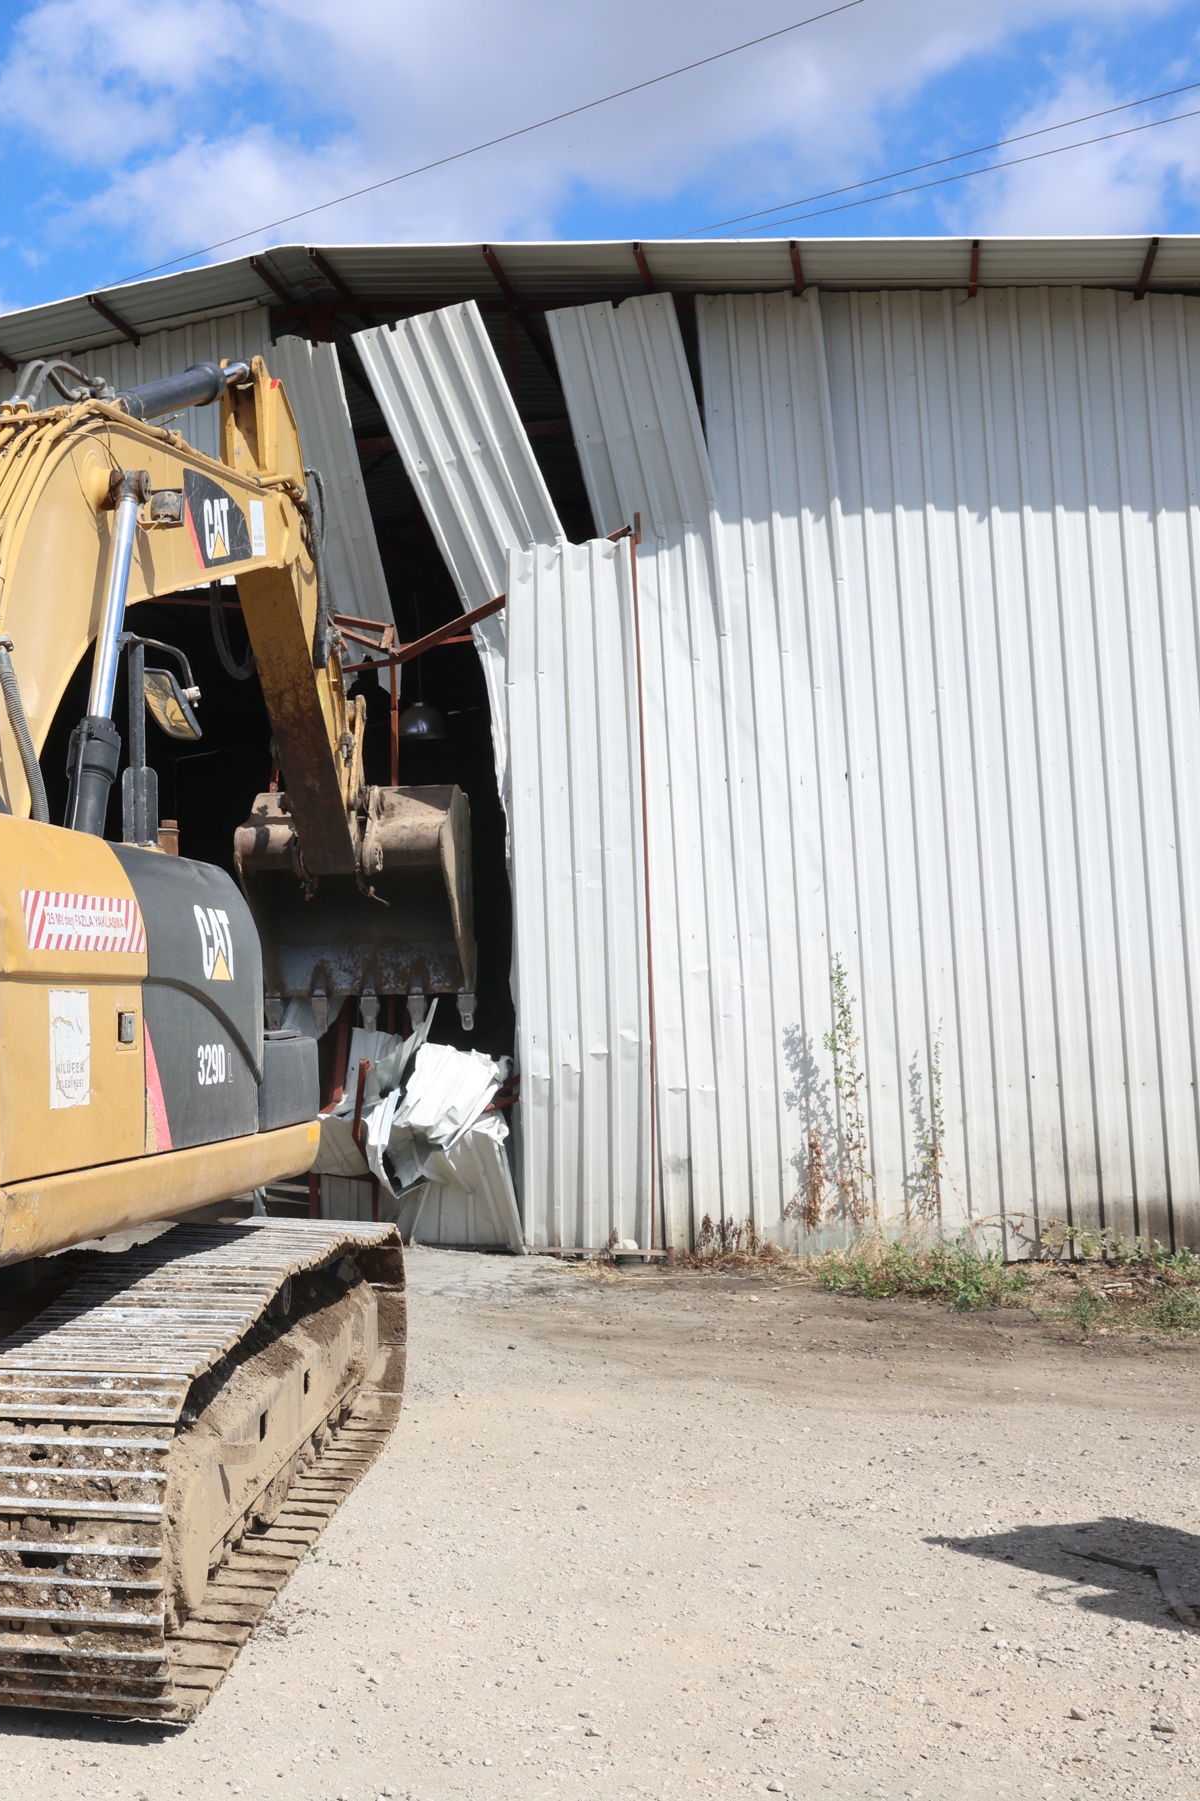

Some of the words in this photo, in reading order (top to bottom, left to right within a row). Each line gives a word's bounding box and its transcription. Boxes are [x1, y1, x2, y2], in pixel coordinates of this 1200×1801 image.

[203, 498, 230, 560] CAT
[47, 912, 56, 925] 25
[74, 914, 94, 927] FAZLA
[94, 915, 125, 931] YAKLAŞMA
[193, 904, 234, 981] CAT
[56, 1059, 85, 1075] NİLÜFER
[197, 1043, 226, 1085] 329D
